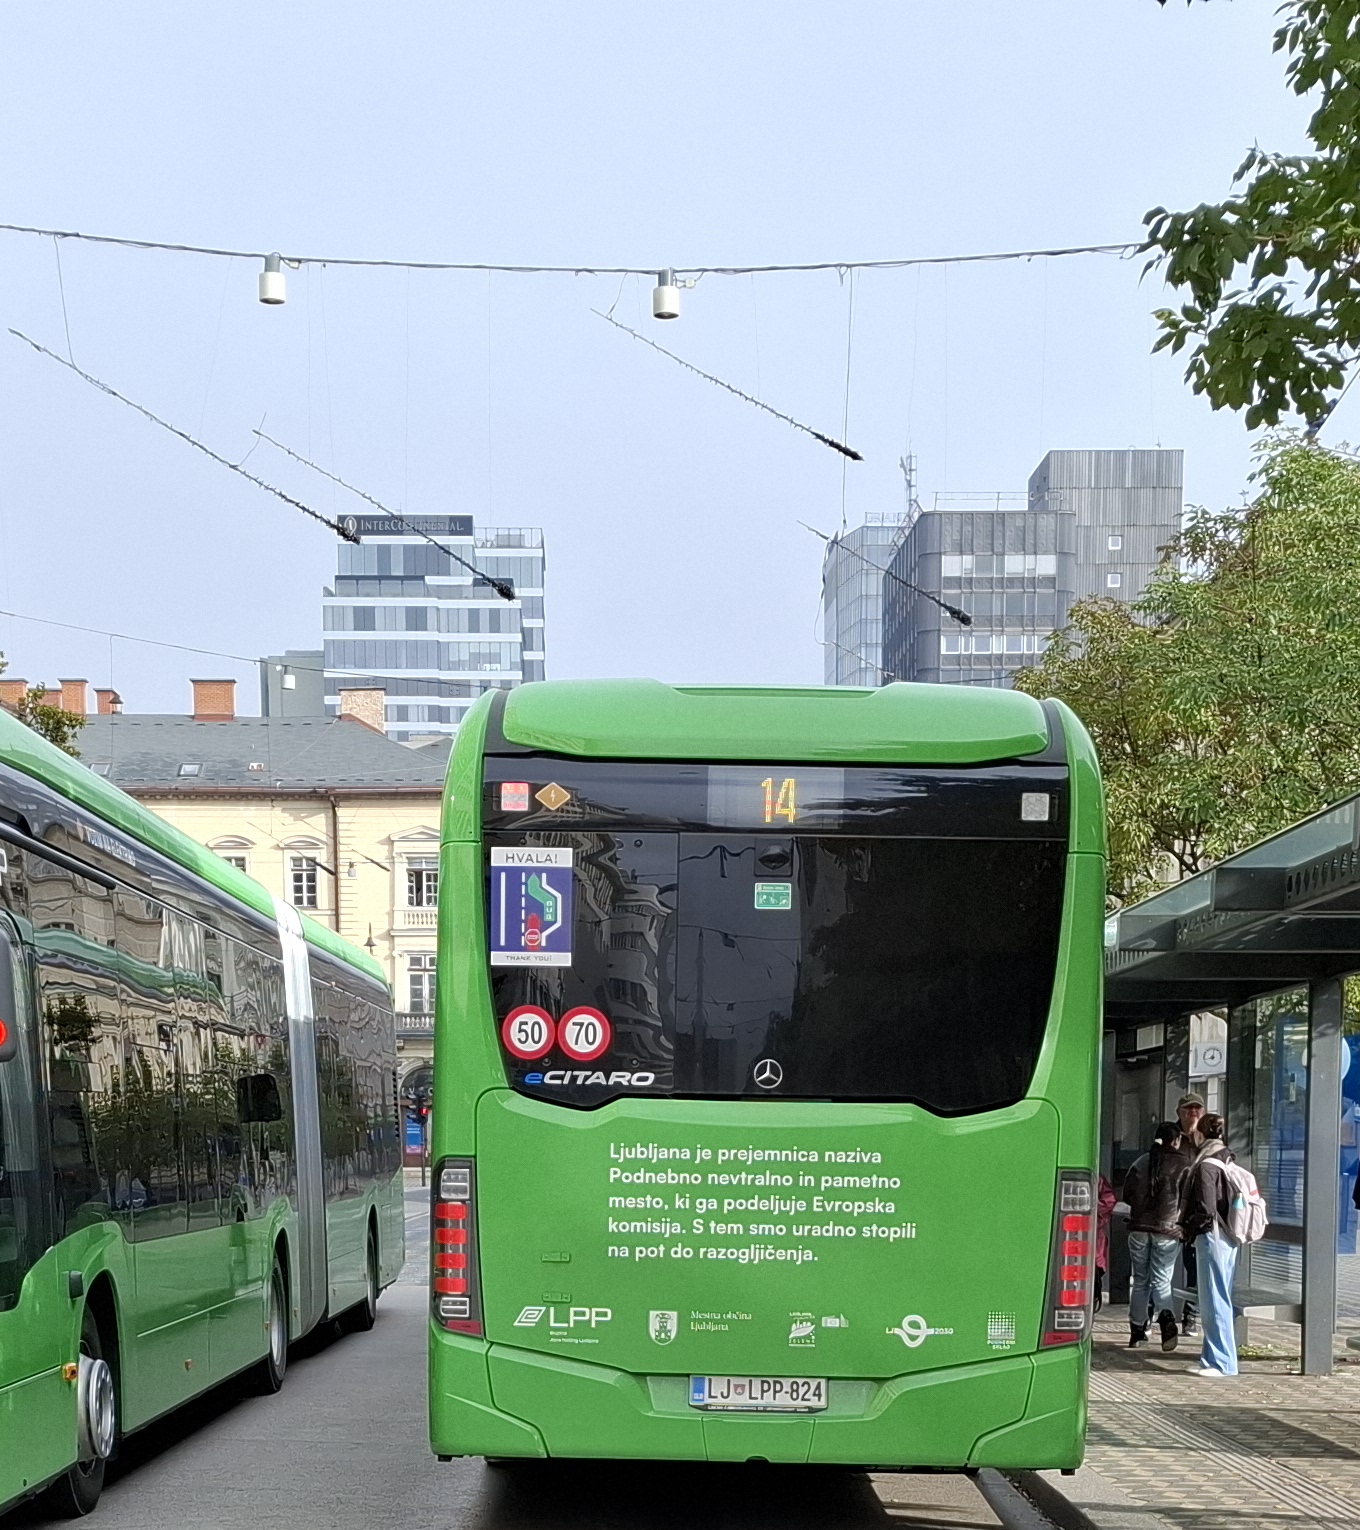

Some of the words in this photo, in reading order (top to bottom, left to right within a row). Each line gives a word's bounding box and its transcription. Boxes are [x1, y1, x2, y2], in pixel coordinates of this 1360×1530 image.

[760, 777, 797, 823] 14
[505, 853, 558, 865] HVALA!
[516, 1021, 543, 1046] 50
[572, 1021, 598, 1047] 70
[524, 1069, 655, 1087] eCITARO
[610, 1143, 690, 1163] Ljubljana
[695, 1144, 712, 1164] je
[717, 1145, 819, 1165] prejemnica
[824, 1147, 882, 1163] naziva
[609, 1168, 702, 1184] Podnebno
[708, 1170, 793, 1186] nevtralno
[799, 1171, 815, 1187] in
[821, 1174, 901, 1191] pametno
[608, 1194, 669, 1210] mesto,
[675, 1193, 690, 1209] ki
[695, 1198, 718, 1213] ga
[723, 1195, 807, 1215] podeljuje
[813, 1196, 896, 1216] Evropska
[608, 1216, 686, 1237] komisija.
[692, 1218, 704, 1234] S
[709, 1220, 743, 1234] tem
[749, 1224, 786, 1236] smo
[792, 1221, 857, 1237] uradno
[861, 1222, 917, 1242] stopili
[607, 1245, 629, 1257] na
[635, 1244, 665, 1261] pot
[670, 1243, 693, 1258] do
[699, 1244, 818, 1265] razogljičenja.
[549, 1306, 612, 1328] LPP
[690, 1311, 721, 1319] Mestna
[723, 1311, 753, 1320] občina
[690, 1321, 729, 1332] Ljubljana
[707, 1378, 731, 1399] LJ
[748, 1379, 823, 1402] LPP-824
